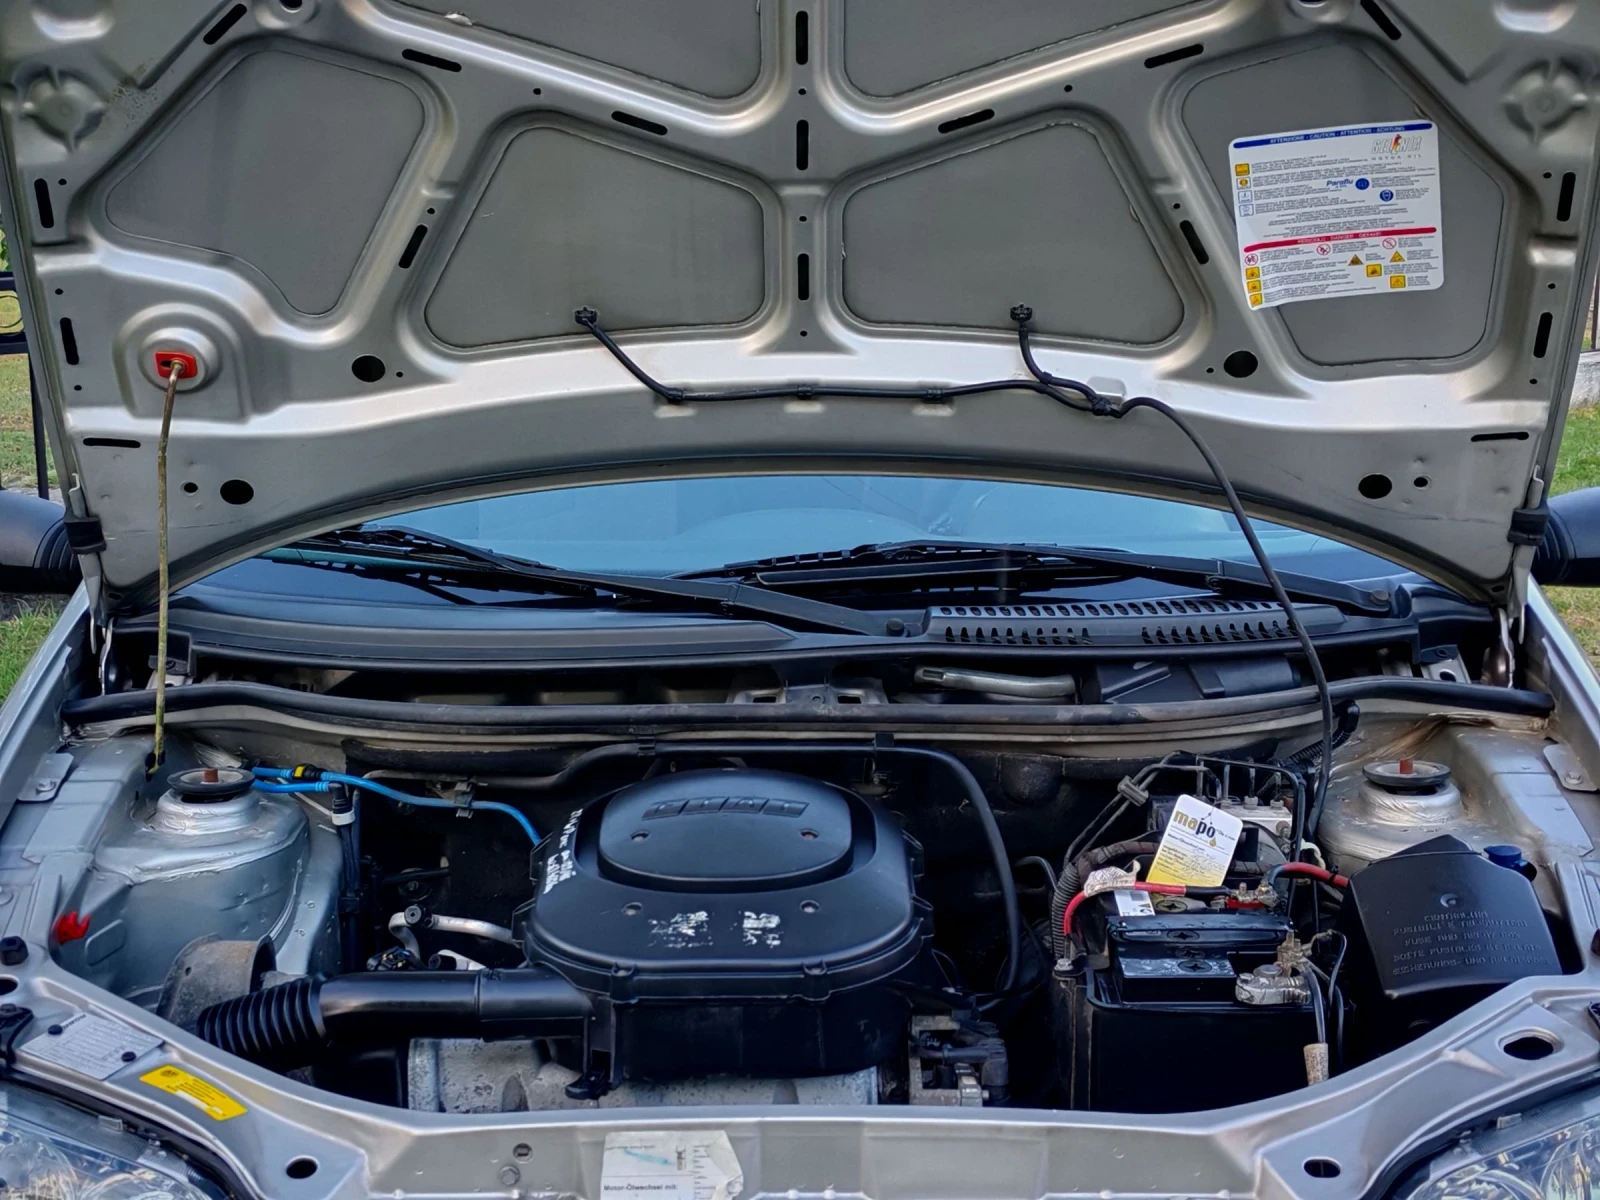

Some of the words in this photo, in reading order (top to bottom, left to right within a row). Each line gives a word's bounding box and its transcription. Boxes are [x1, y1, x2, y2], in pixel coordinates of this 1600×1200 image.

[1310, 132, 1336, 140] CAUTION
[1173, 810, 1216, 838] mapo
[604, 1183, 663, 1191] Motor-Ölwechsel
